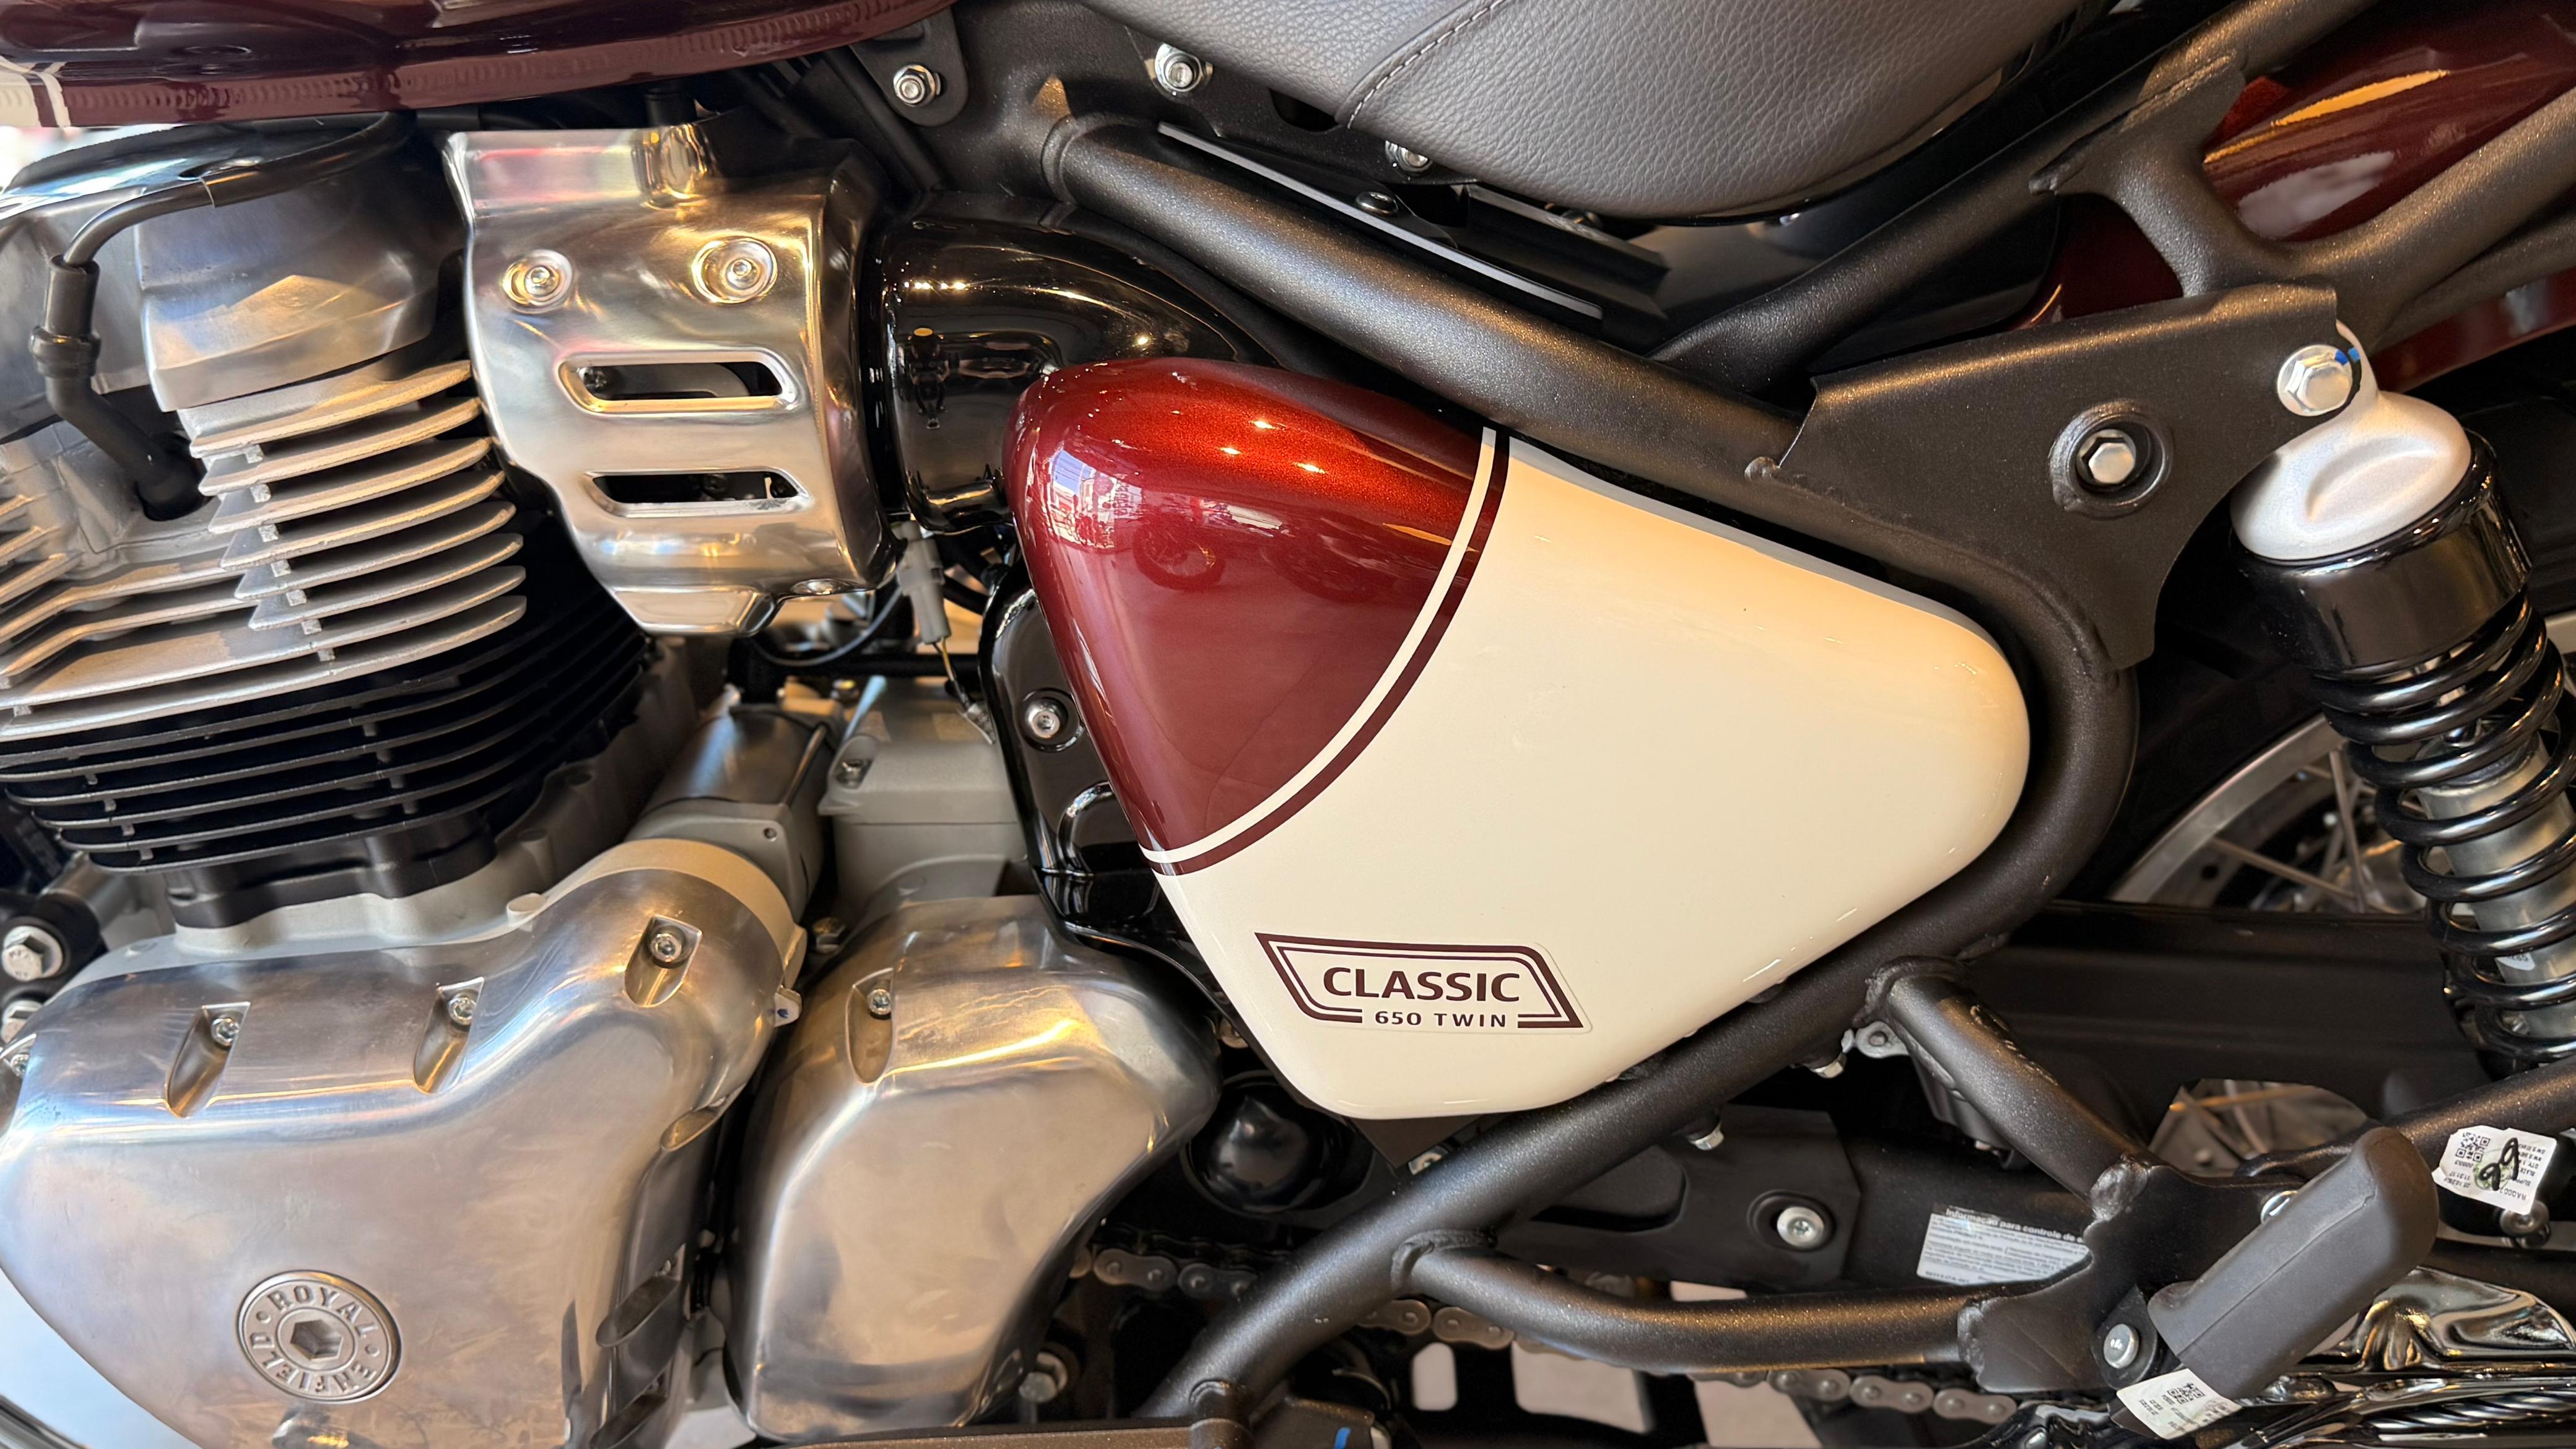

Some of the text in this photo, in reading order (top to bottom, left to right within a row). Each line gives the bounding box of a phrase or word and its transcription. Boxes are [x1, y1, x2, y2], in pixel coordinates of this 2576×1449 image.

[1323, 967, 1520, 1002] CLASSIC
[1374, 1011, 1506, 1028] 650 TWIN
[1999, 1221, 2022, 1232] para
[2023, 1224, 2061, 1239] controle
[250, 1285, 378, 1393] ROYAL ENFIELD
